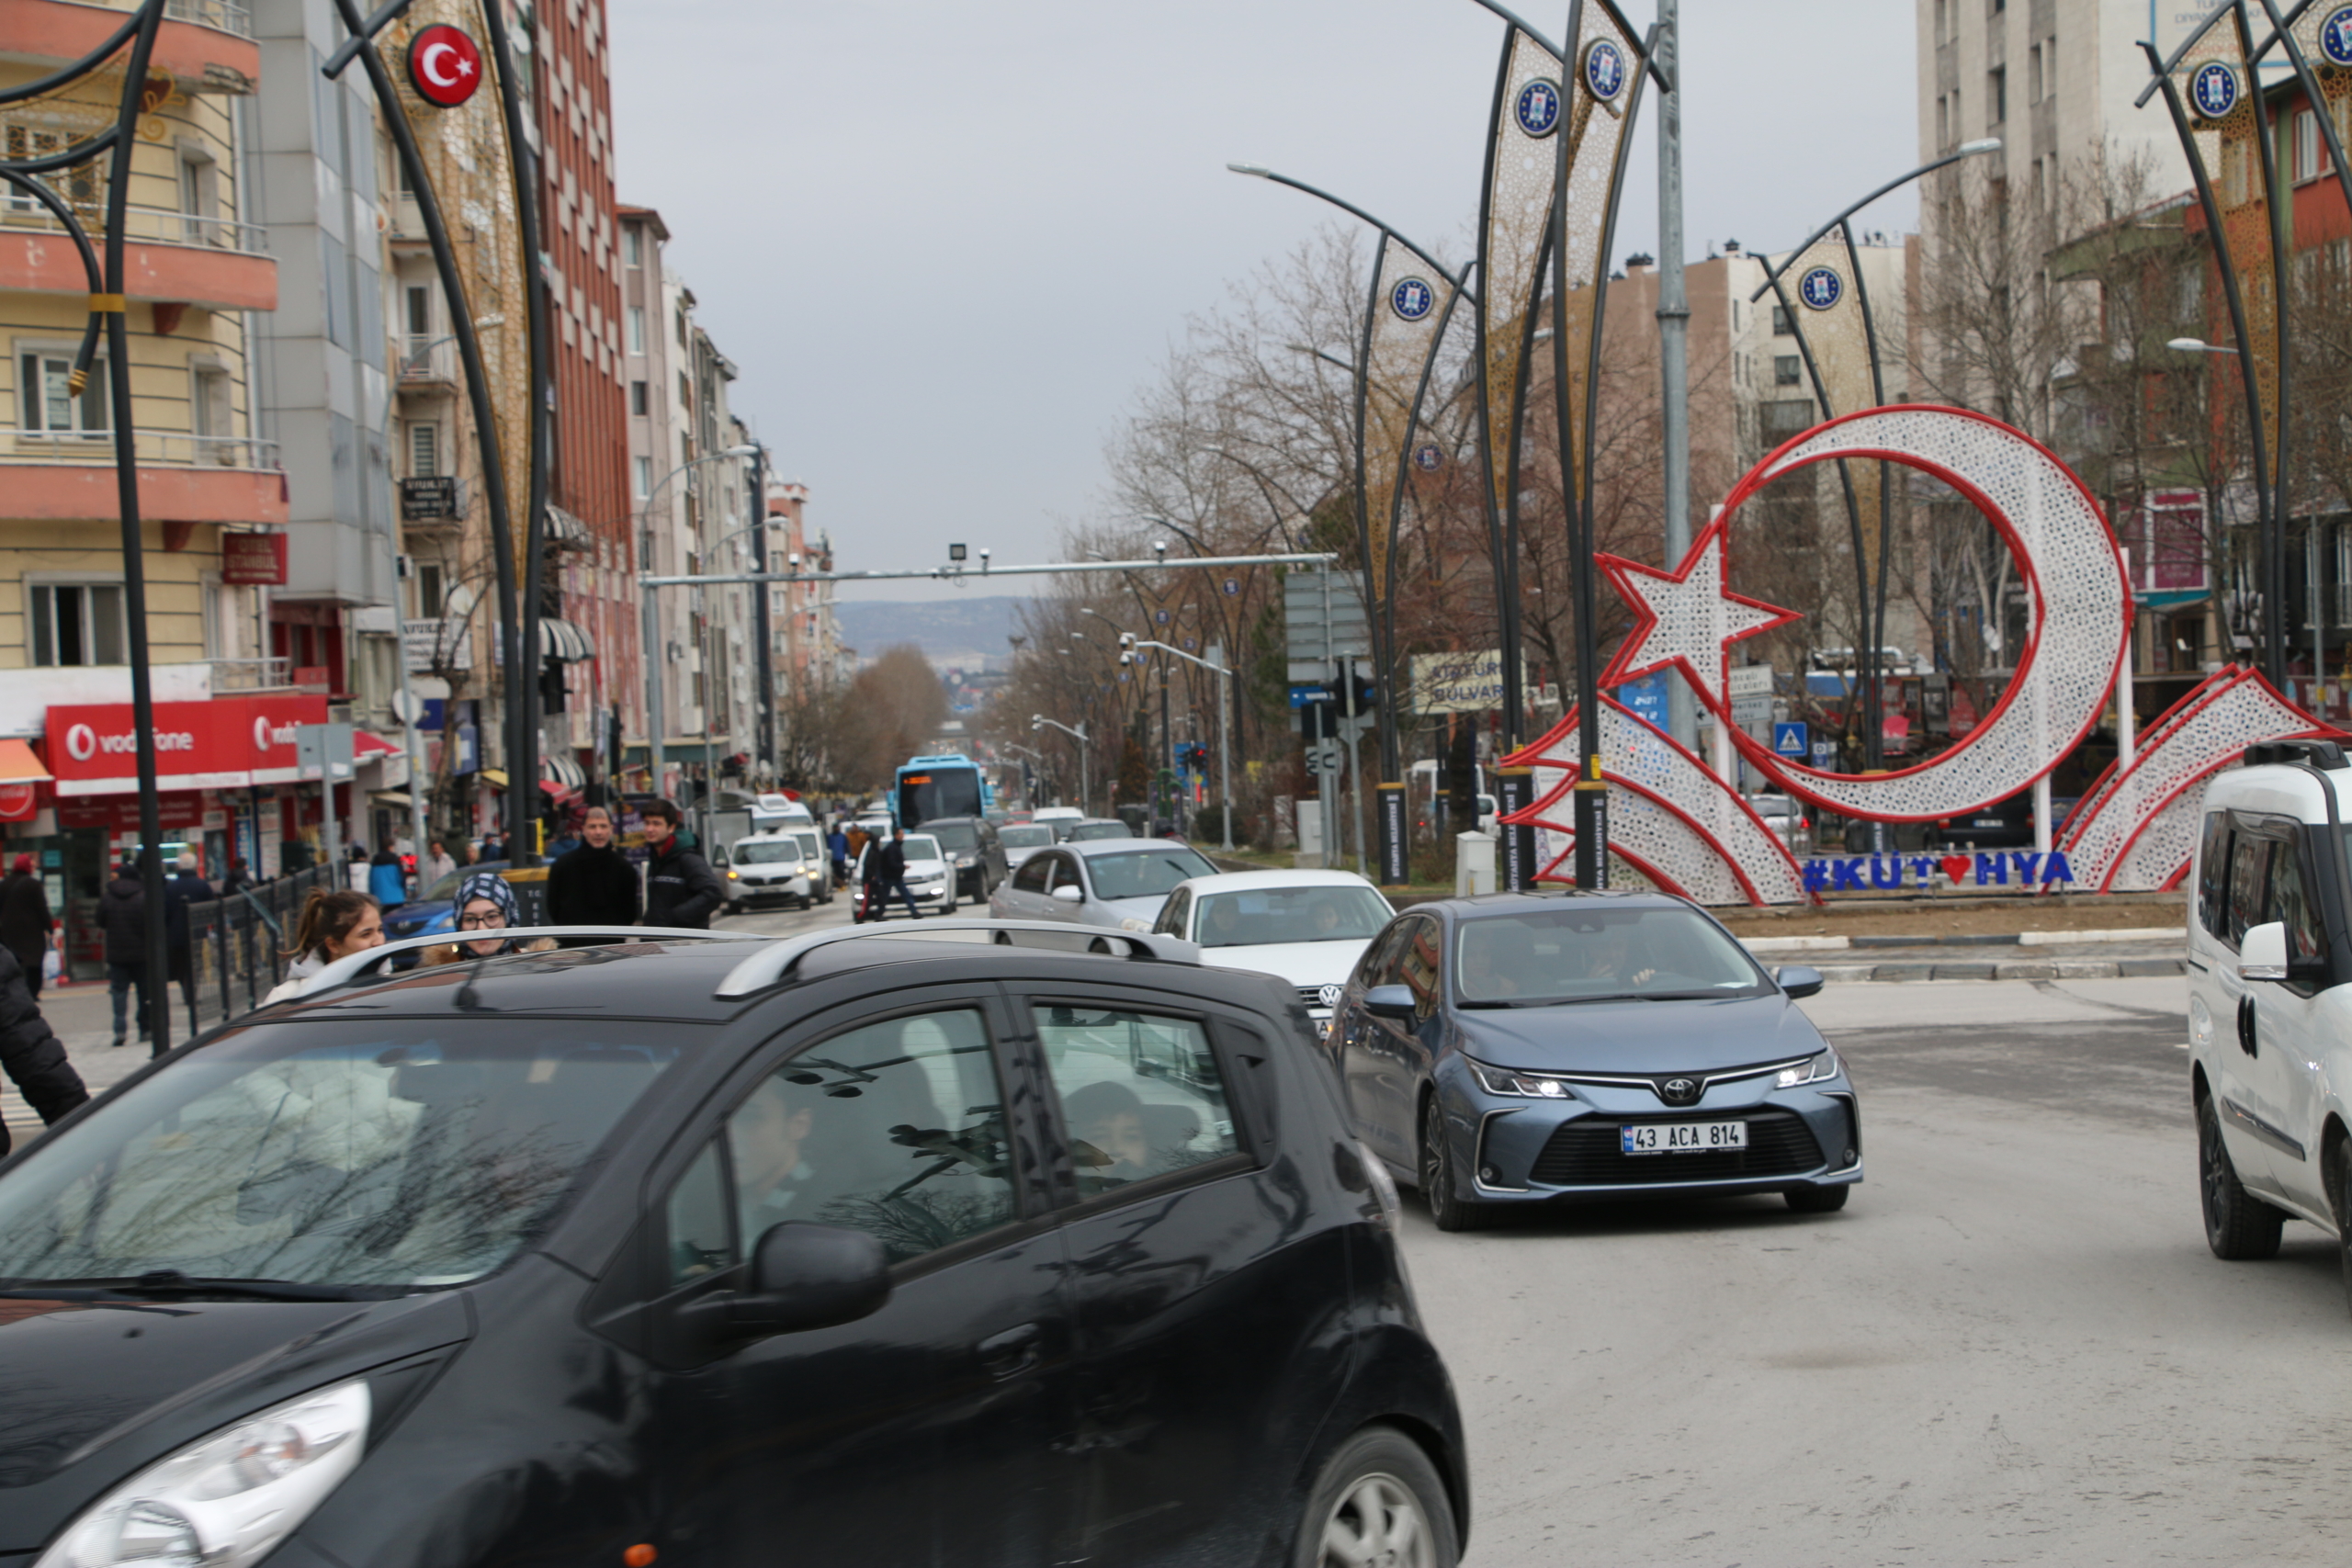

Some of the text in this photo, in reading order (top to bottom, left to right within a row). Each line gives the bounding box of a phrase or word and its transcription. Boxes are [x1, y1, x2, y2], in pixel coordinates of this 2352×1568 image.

[227, 554, 279, 570] STANBUL
[1432, 661, 1504, 679] ATATÜR
[1433, 684, 1504, 701] BULVAR
[99, 726, 194, 753] vodone
[1635, 1129, 1657, 1148] 43
[1668, 1126, 1700, 1146] ACA
[1710, 1125, 1739, 1145] 814
